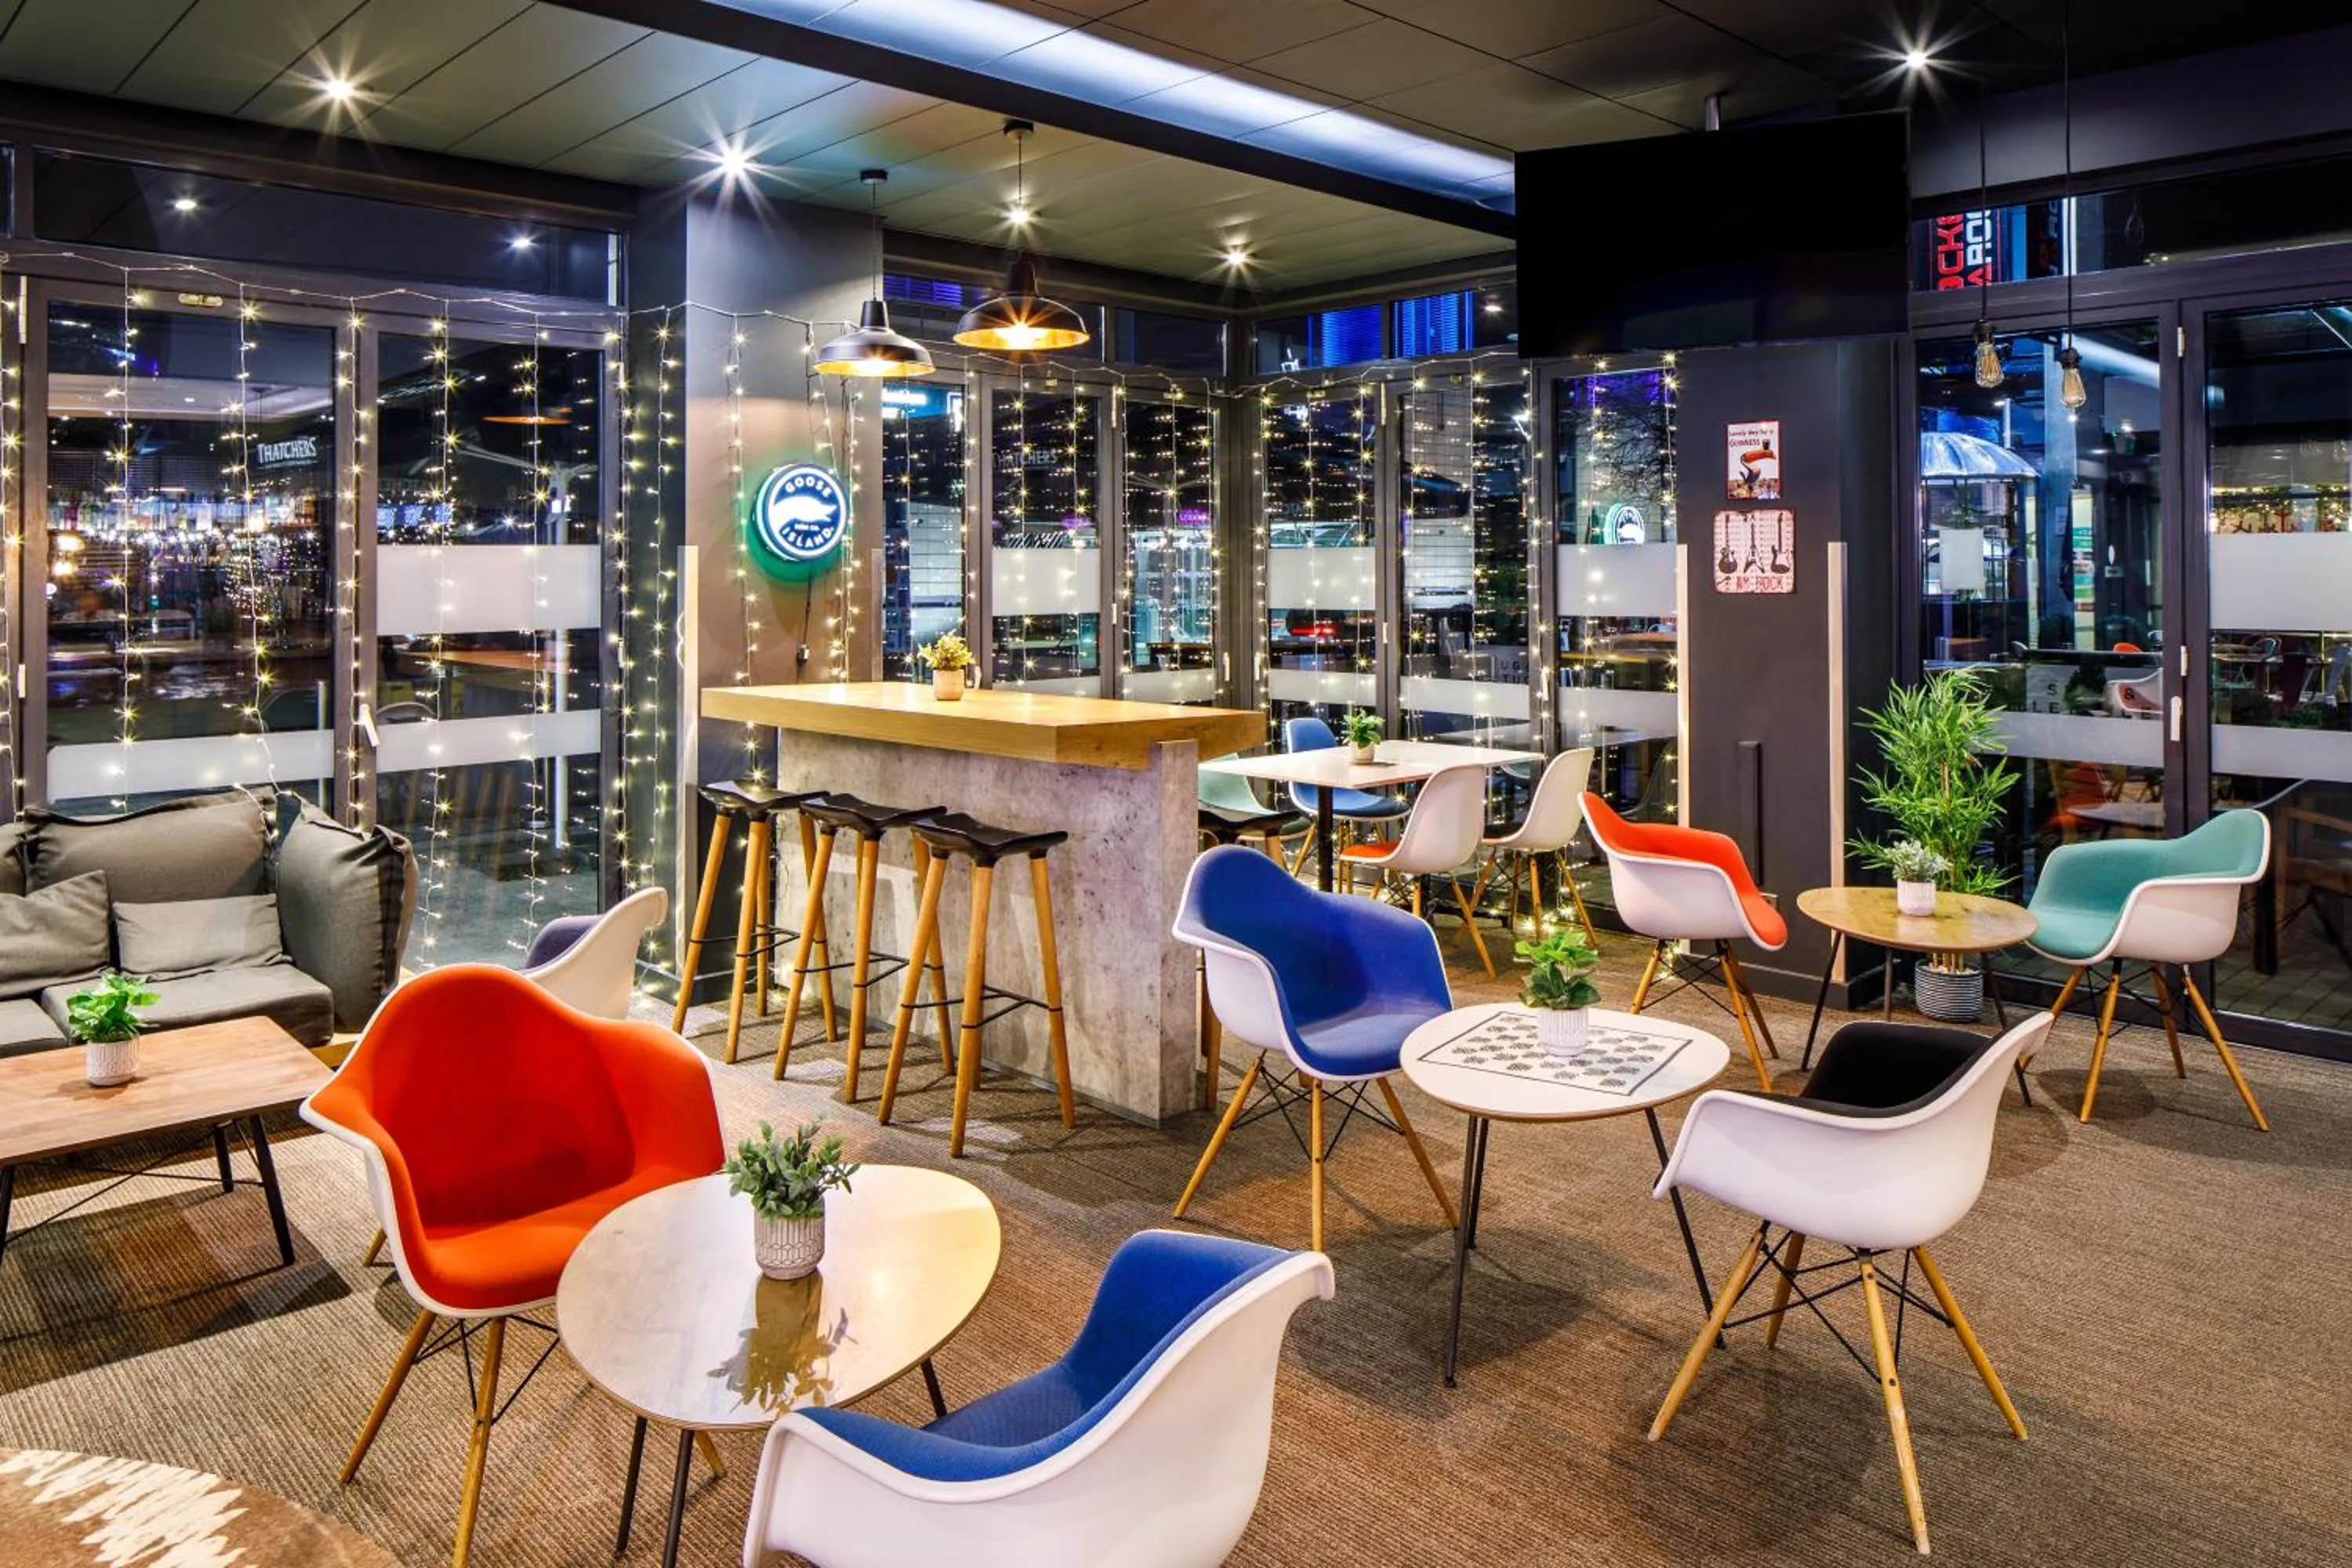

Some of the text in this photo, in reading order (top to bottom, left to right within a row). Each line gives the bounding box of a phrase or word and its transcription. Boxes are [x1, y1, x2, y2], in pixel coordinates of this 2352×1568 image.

[257, 437, 317, 463] THATCHERS
[786, 477, 832, 498] GOOSE
[782, 527, 832, 548] ISLAND
